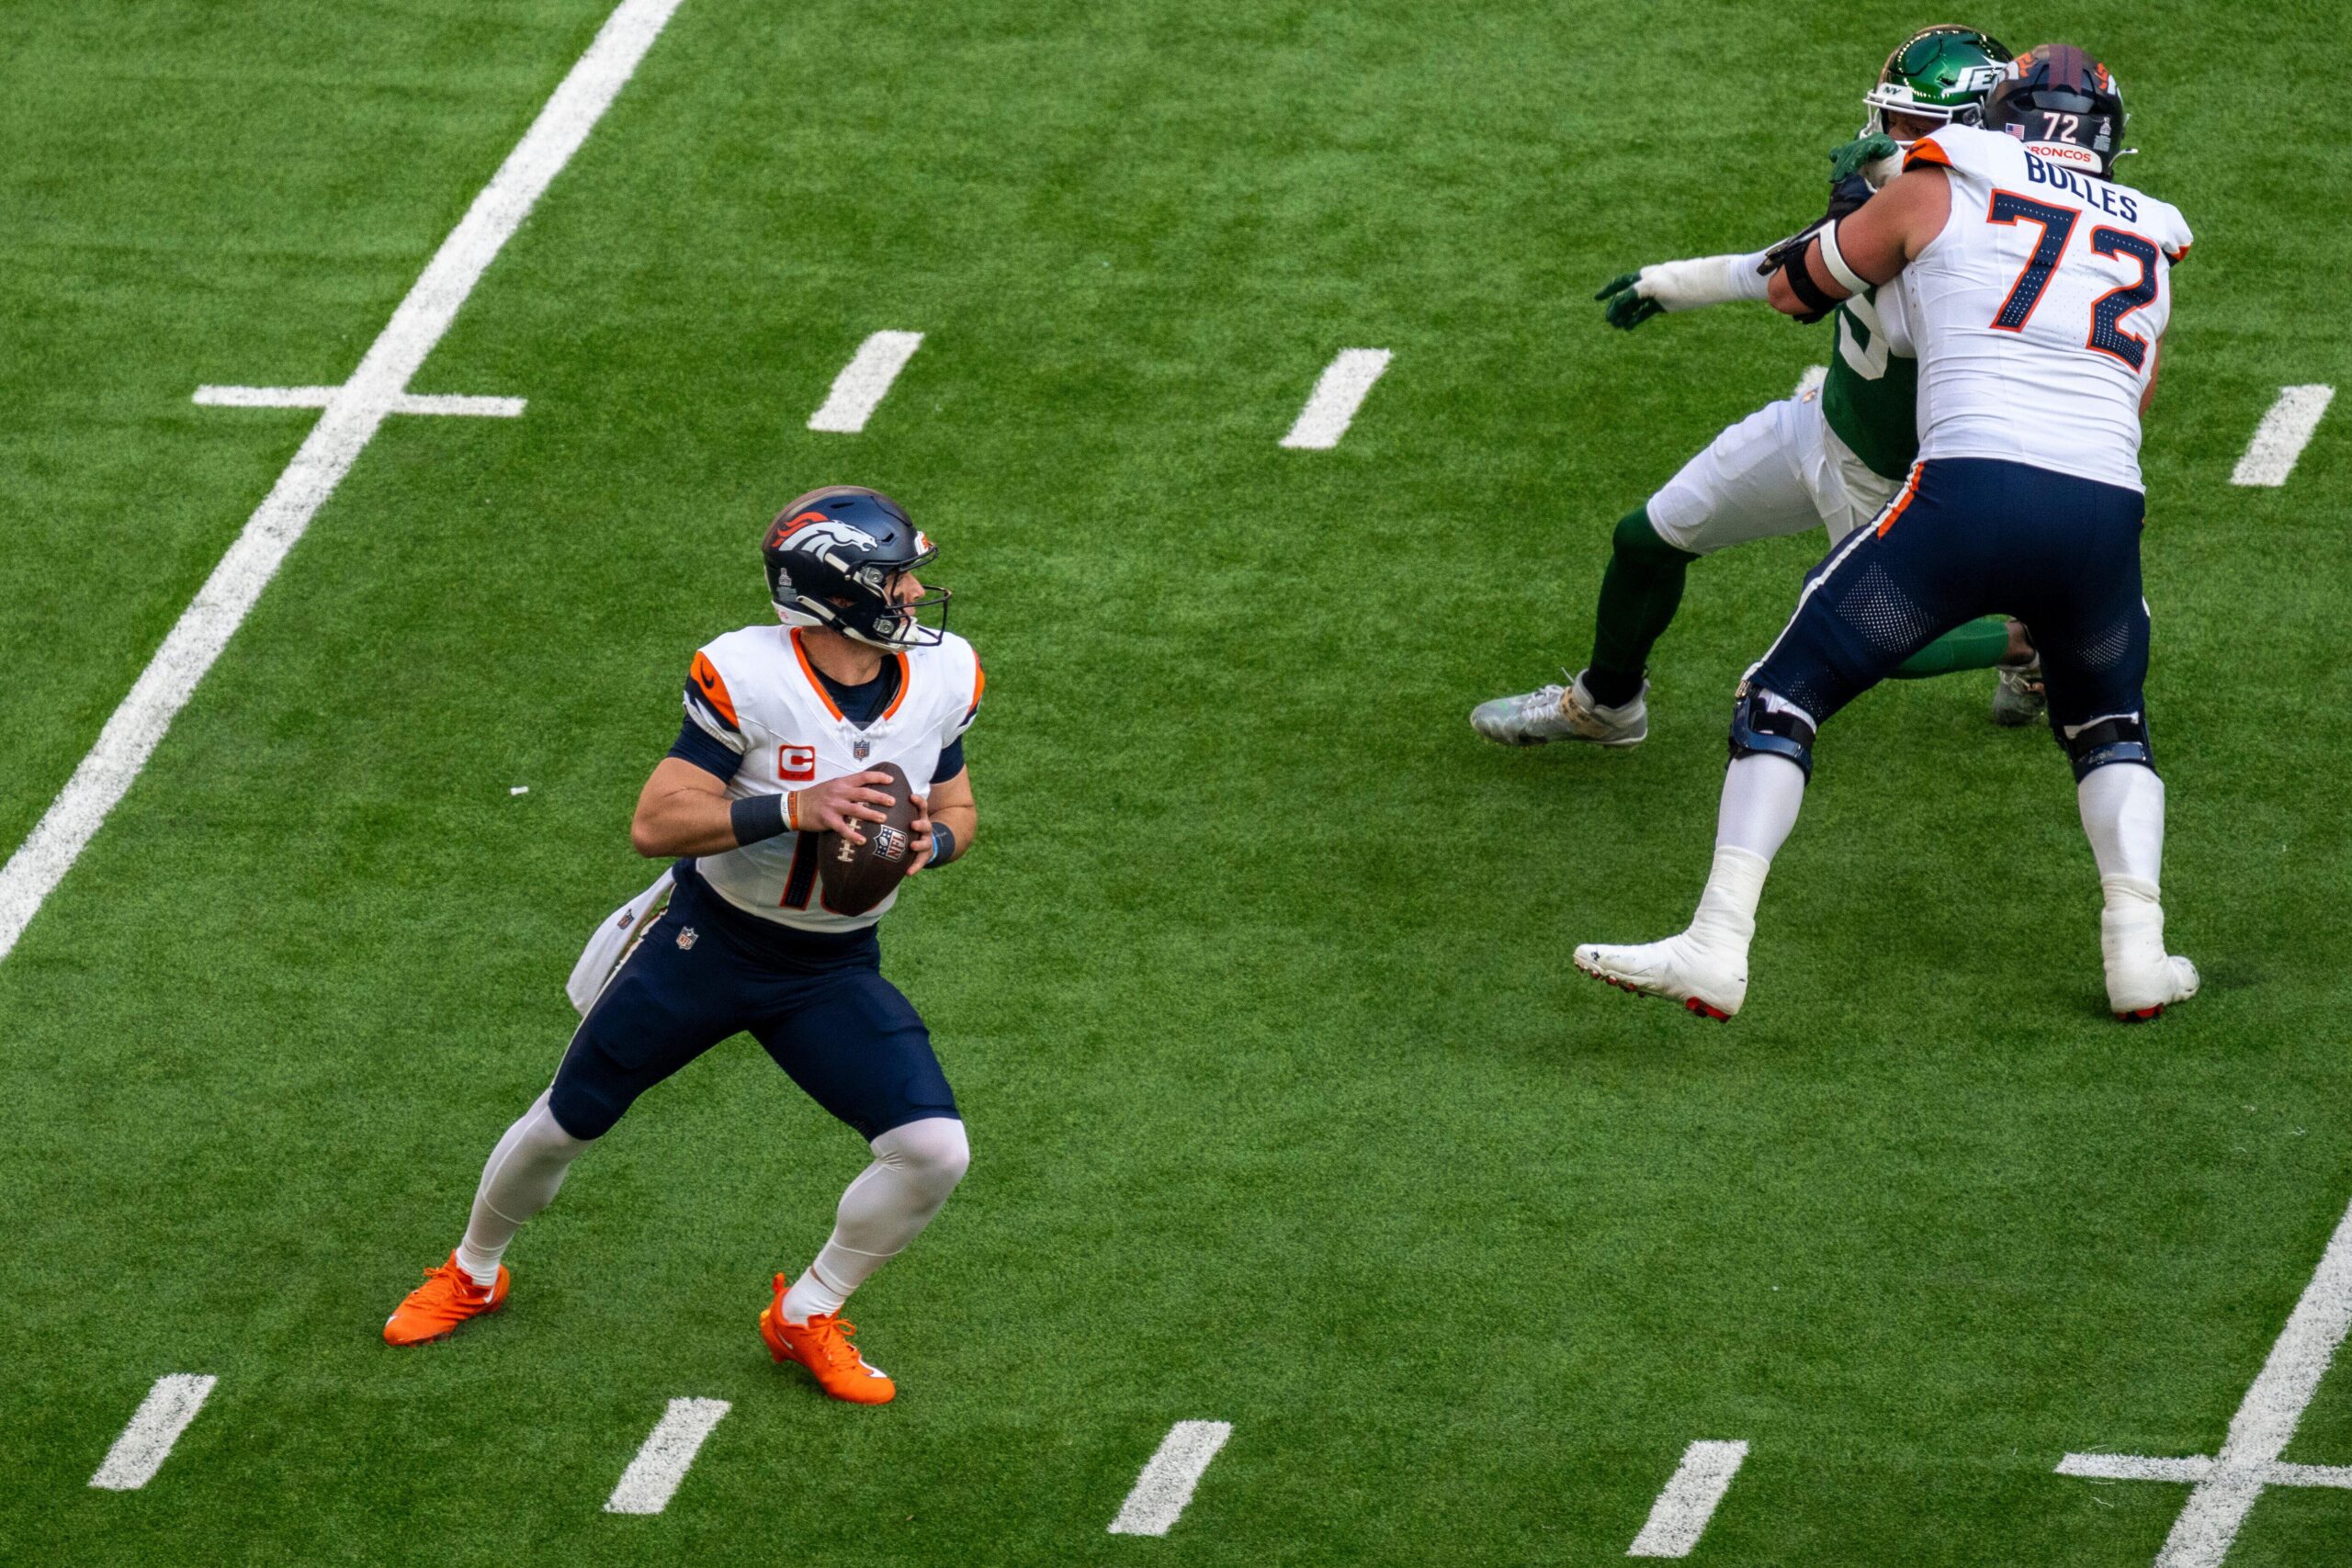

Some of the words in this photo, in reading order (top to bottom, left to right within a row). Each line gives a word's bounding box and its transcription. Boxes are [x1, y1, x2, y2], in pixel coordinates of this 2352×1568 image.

[1883, 86, 1902, 95] NY
[2043, 111, 2079, 144] 72
[2028, 146, 2091, 163] RONCOS
[2024, 151, 2138, 223] BOLLES
[1986, 188, 2159, 374] 72
[782, 749, 813, 772] C
[888, 835, 906, 859] NFL
